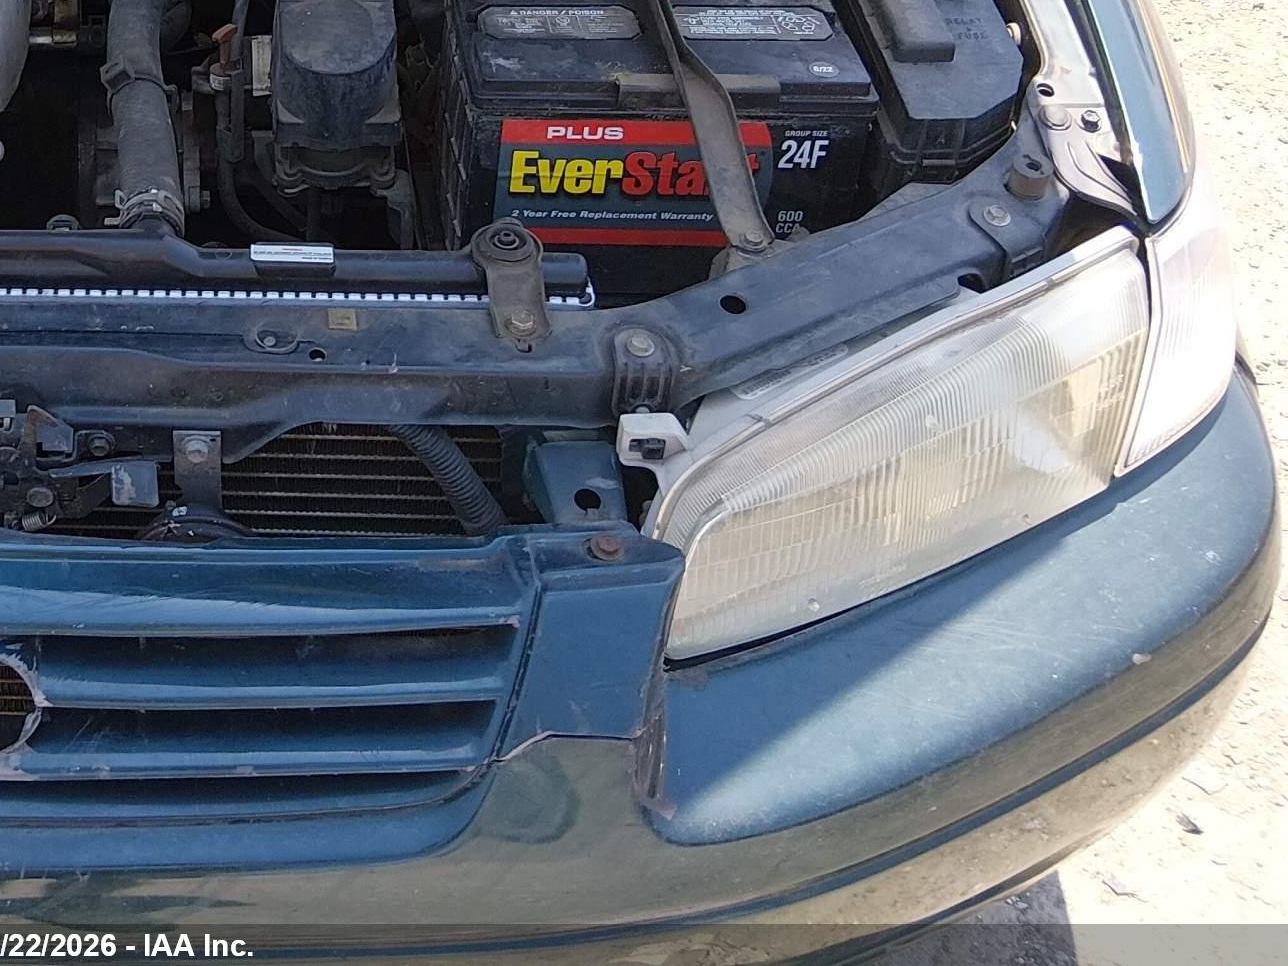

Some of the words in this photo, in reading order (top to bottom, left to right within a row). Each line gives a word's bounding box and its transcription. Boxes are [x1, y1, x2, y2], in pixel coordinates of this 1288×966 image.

[546, 126, 624, 140] PLUS
[777, 139, 830, 170] 24F
[511, 209, 520, 218] 2
[522, 209, 549, 218] Year
[550, 210, 577, 219] Free
[579, 210, 658, 220] Replacement
[660, 211, 715, 222] Warranty
[777, 210, 804, 223] 600
[775, 222, 802, 234] CCA
